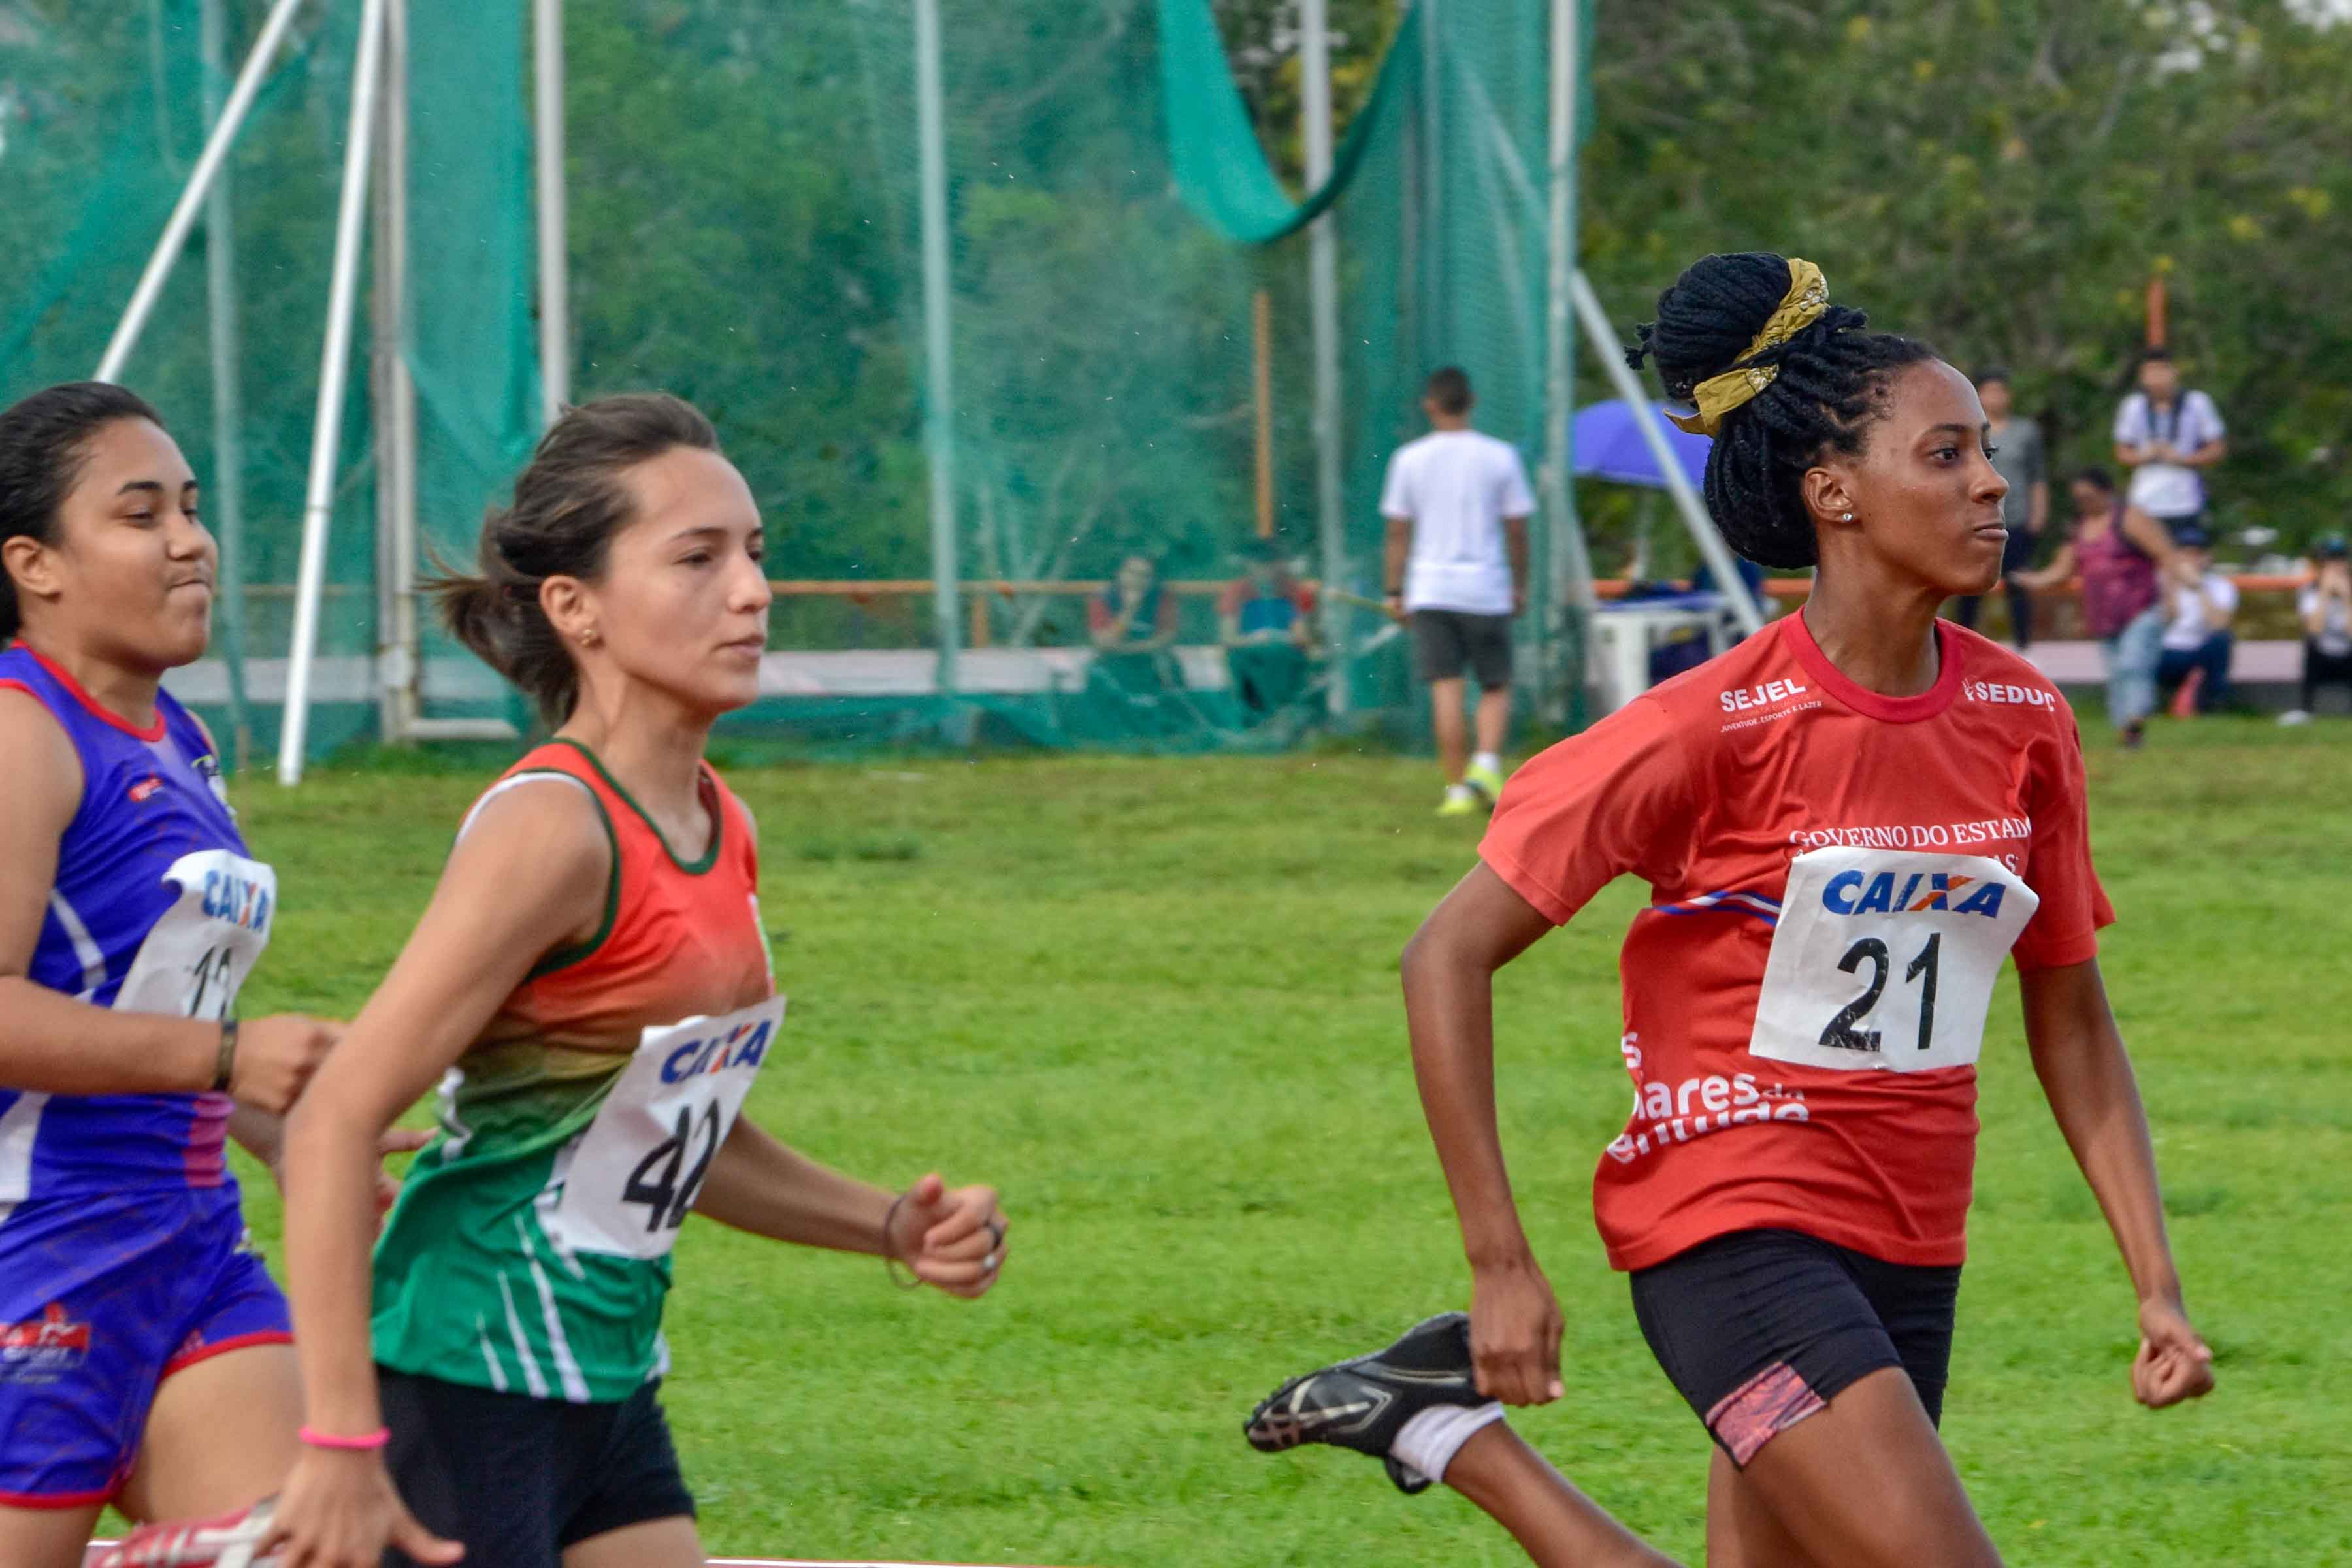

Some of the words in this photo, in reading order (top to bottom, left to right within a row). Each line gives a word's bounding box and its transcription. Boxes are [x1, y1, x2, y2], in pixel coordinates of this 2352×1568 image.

[1720, 678, 1806, 712] SEJEL
[1975, 681, 2055, 712] SEDUC
[1760, 709, 1791, 724] ESPORTE
[1789, 826, 1908, 847] GOVERNO
[1911, 825, 1950, 846] DO
[201, 870, 269, 930] CAIXA
[1822, 870, 2006, 919] CAIXA
[1819, 932, 1941, 1052] 21
[660, 1019, 772, 1085] CAIXA
